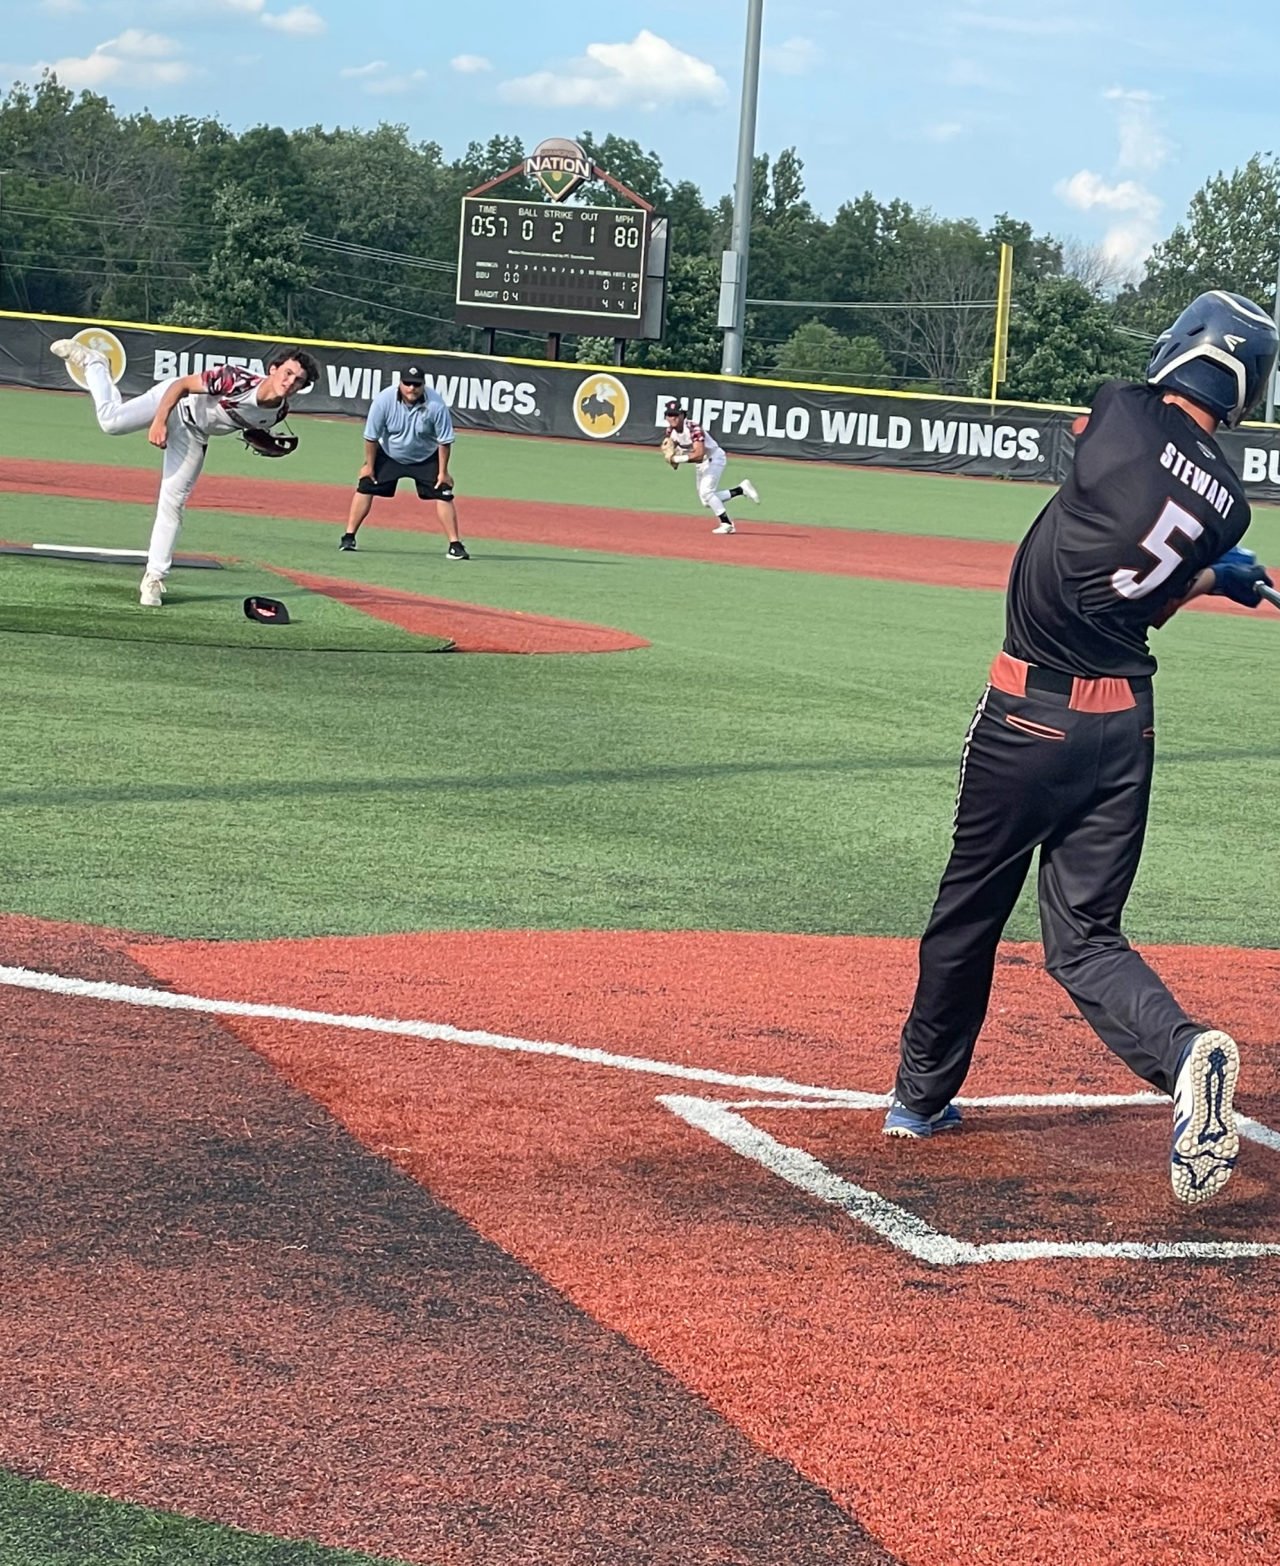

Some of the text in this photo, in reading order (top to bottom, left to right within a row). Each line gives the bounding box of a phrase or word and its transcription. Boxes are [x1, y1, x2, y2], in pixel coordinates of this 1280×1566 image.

[527, 157, 590, 178] NATION
[479, 205, 634, 224] TIME BALL STRIKE OUT MPH
[471, 215, 639, 248] 0:57 0 2 1 80
[502, 290, 509, 301] 0
[504, 272, 510, 283] 0
[513, 272, 520, 283] 0
[603, 279, 610, 290] 0
[424, 373, 537, 416] WINGS
[821, 409, 912, 449] WILD
[921, 418, 1041, 462] WINGS
[1159, 441, 1235, 520] STEWART
[1111, 497, 1205, 600] 5
